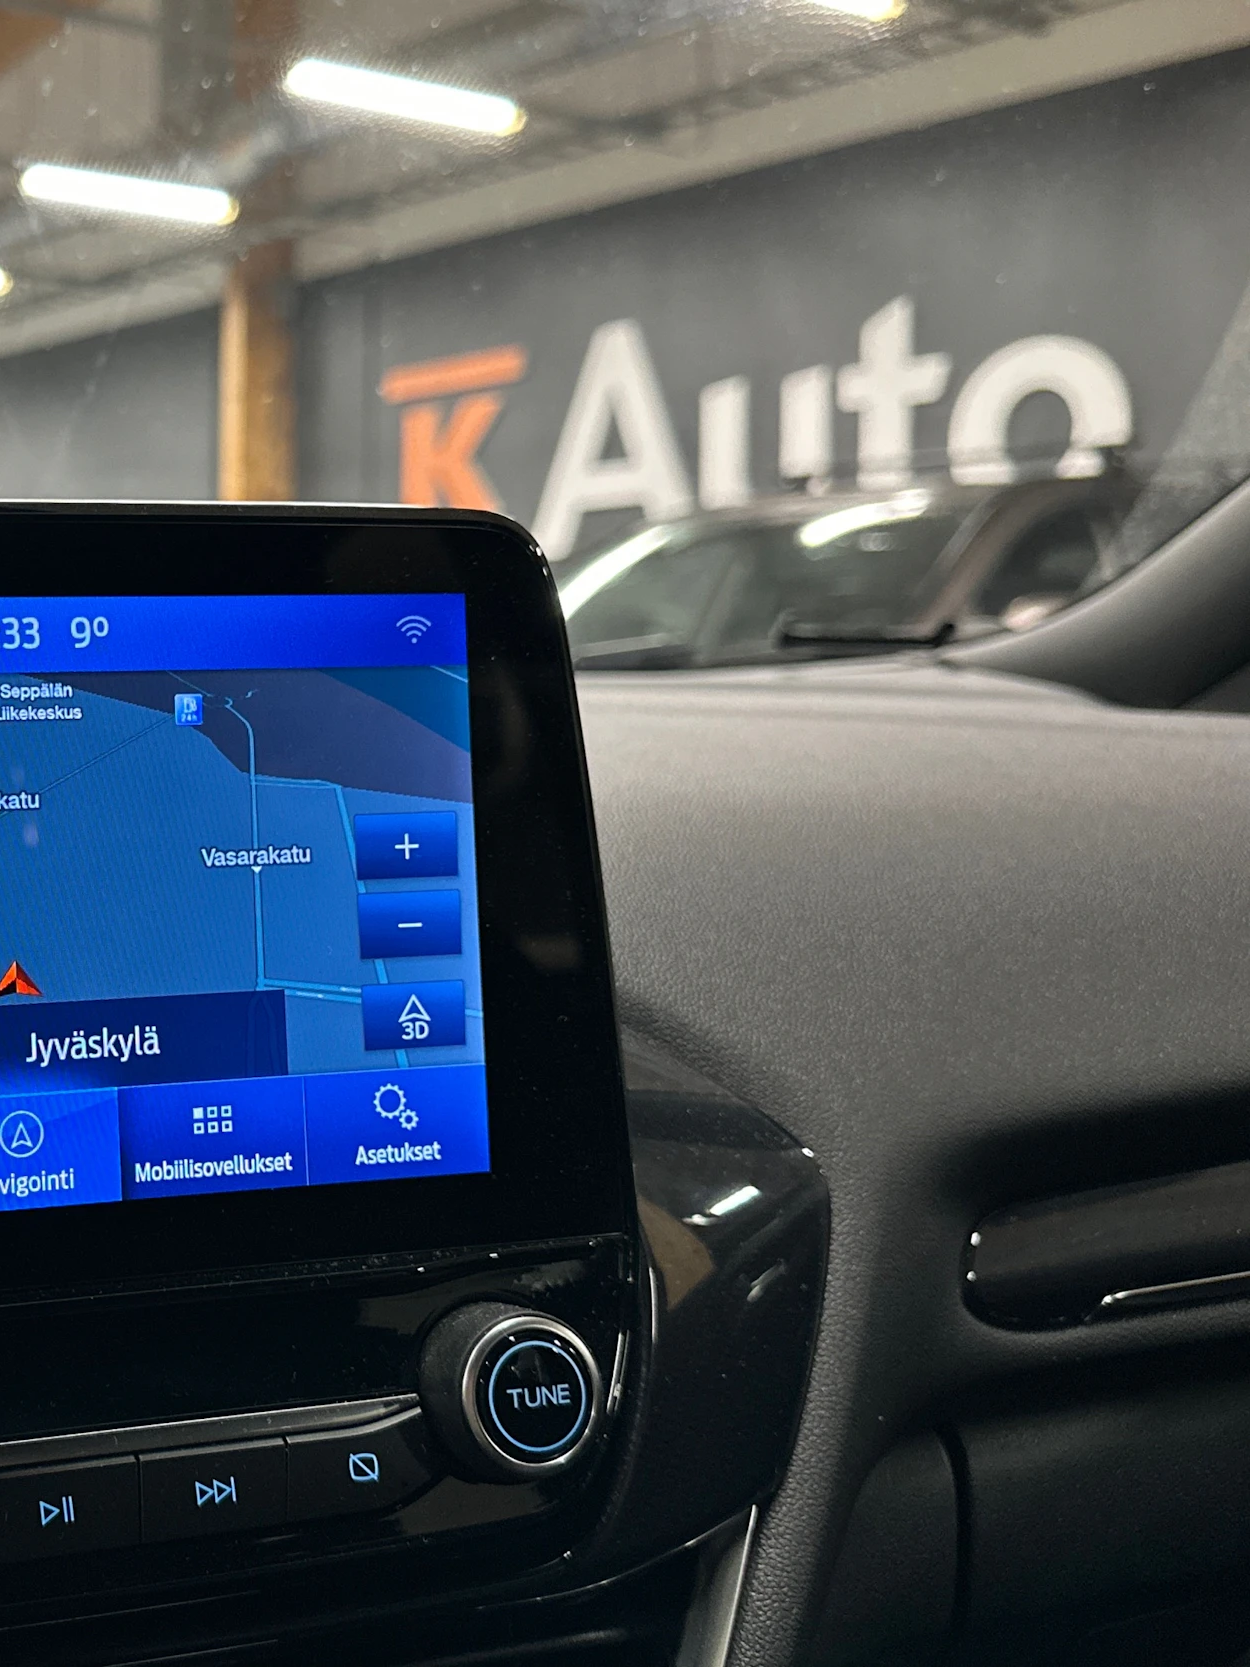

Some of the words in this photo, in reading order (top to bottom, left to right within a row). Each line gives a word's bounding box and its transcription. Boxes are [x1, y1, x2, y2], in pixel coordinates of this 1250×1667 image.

[0, 683, 73, 703] Seppälän
[200, 847, 312, 868] Vasarakatu
[401, 1022, 430, 1040] 3D
[26, 1026, 161, 1067] Jyväskylä
[355, 1141, 442, 1166] Asetukset
[134, 1153, 293, 1183] Mobiilisovellukset
[506, 1383, 571, 1409] TUNE
